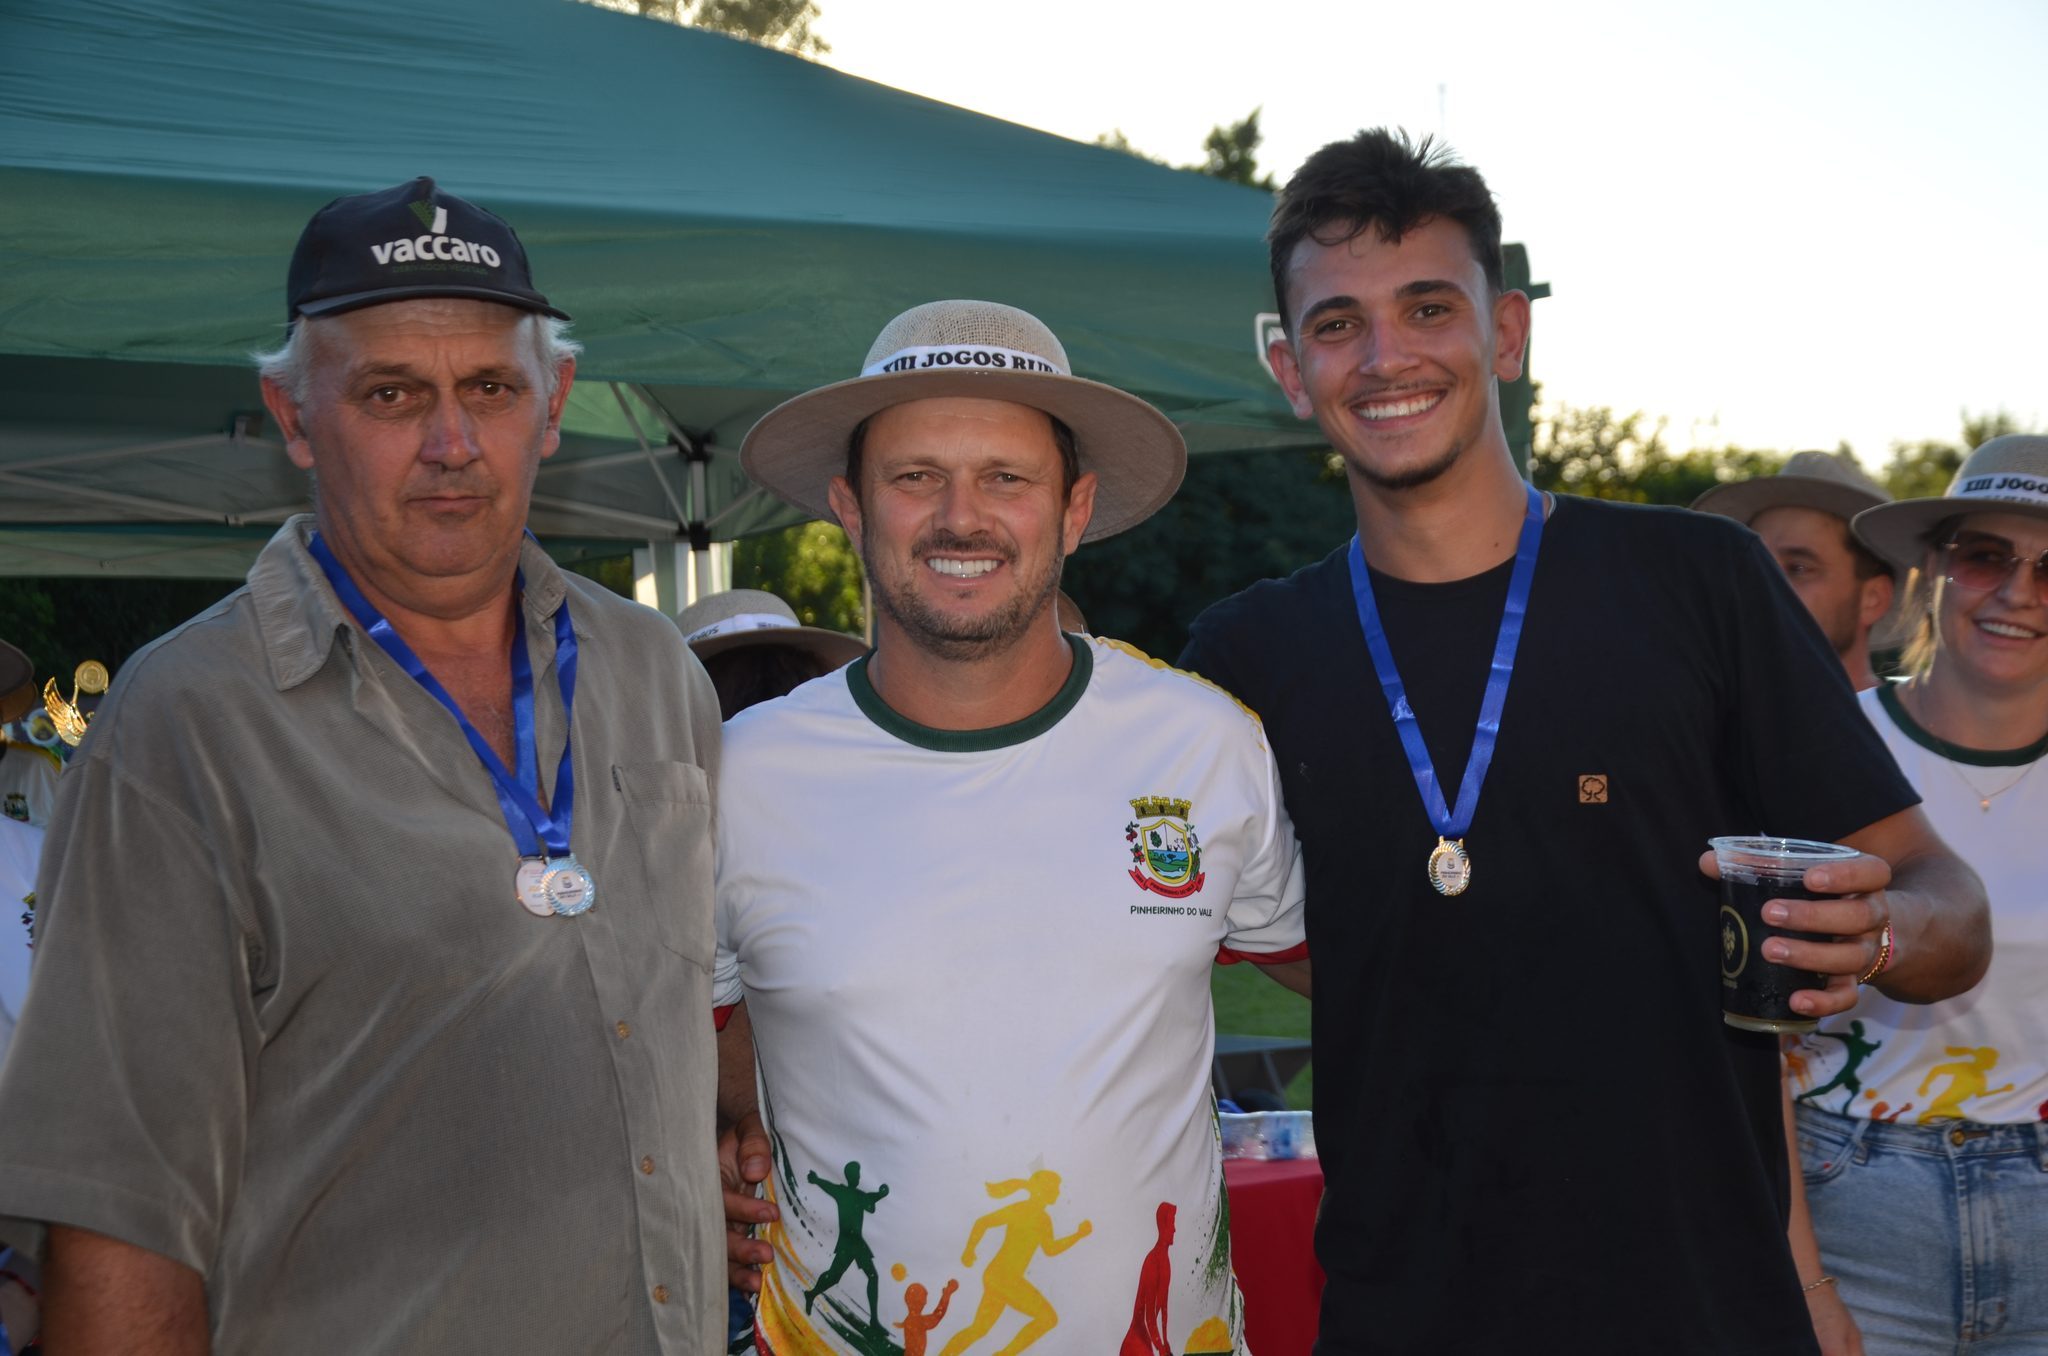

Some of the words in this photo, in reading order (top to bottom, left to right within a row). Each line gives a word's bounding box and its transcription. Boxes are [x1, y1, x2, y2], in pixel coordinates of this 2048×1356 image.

[371, 235, 501, 268] vaccaro
[921, 351, 1006, 368] JOGOS
[1012, 355, 1059, 373] RUR
[1130, 905, 1185, 916] PINHEIRINHO
[1186, 907, 1198, 916] DO
[1199, 908, 1213, 917] VALE
